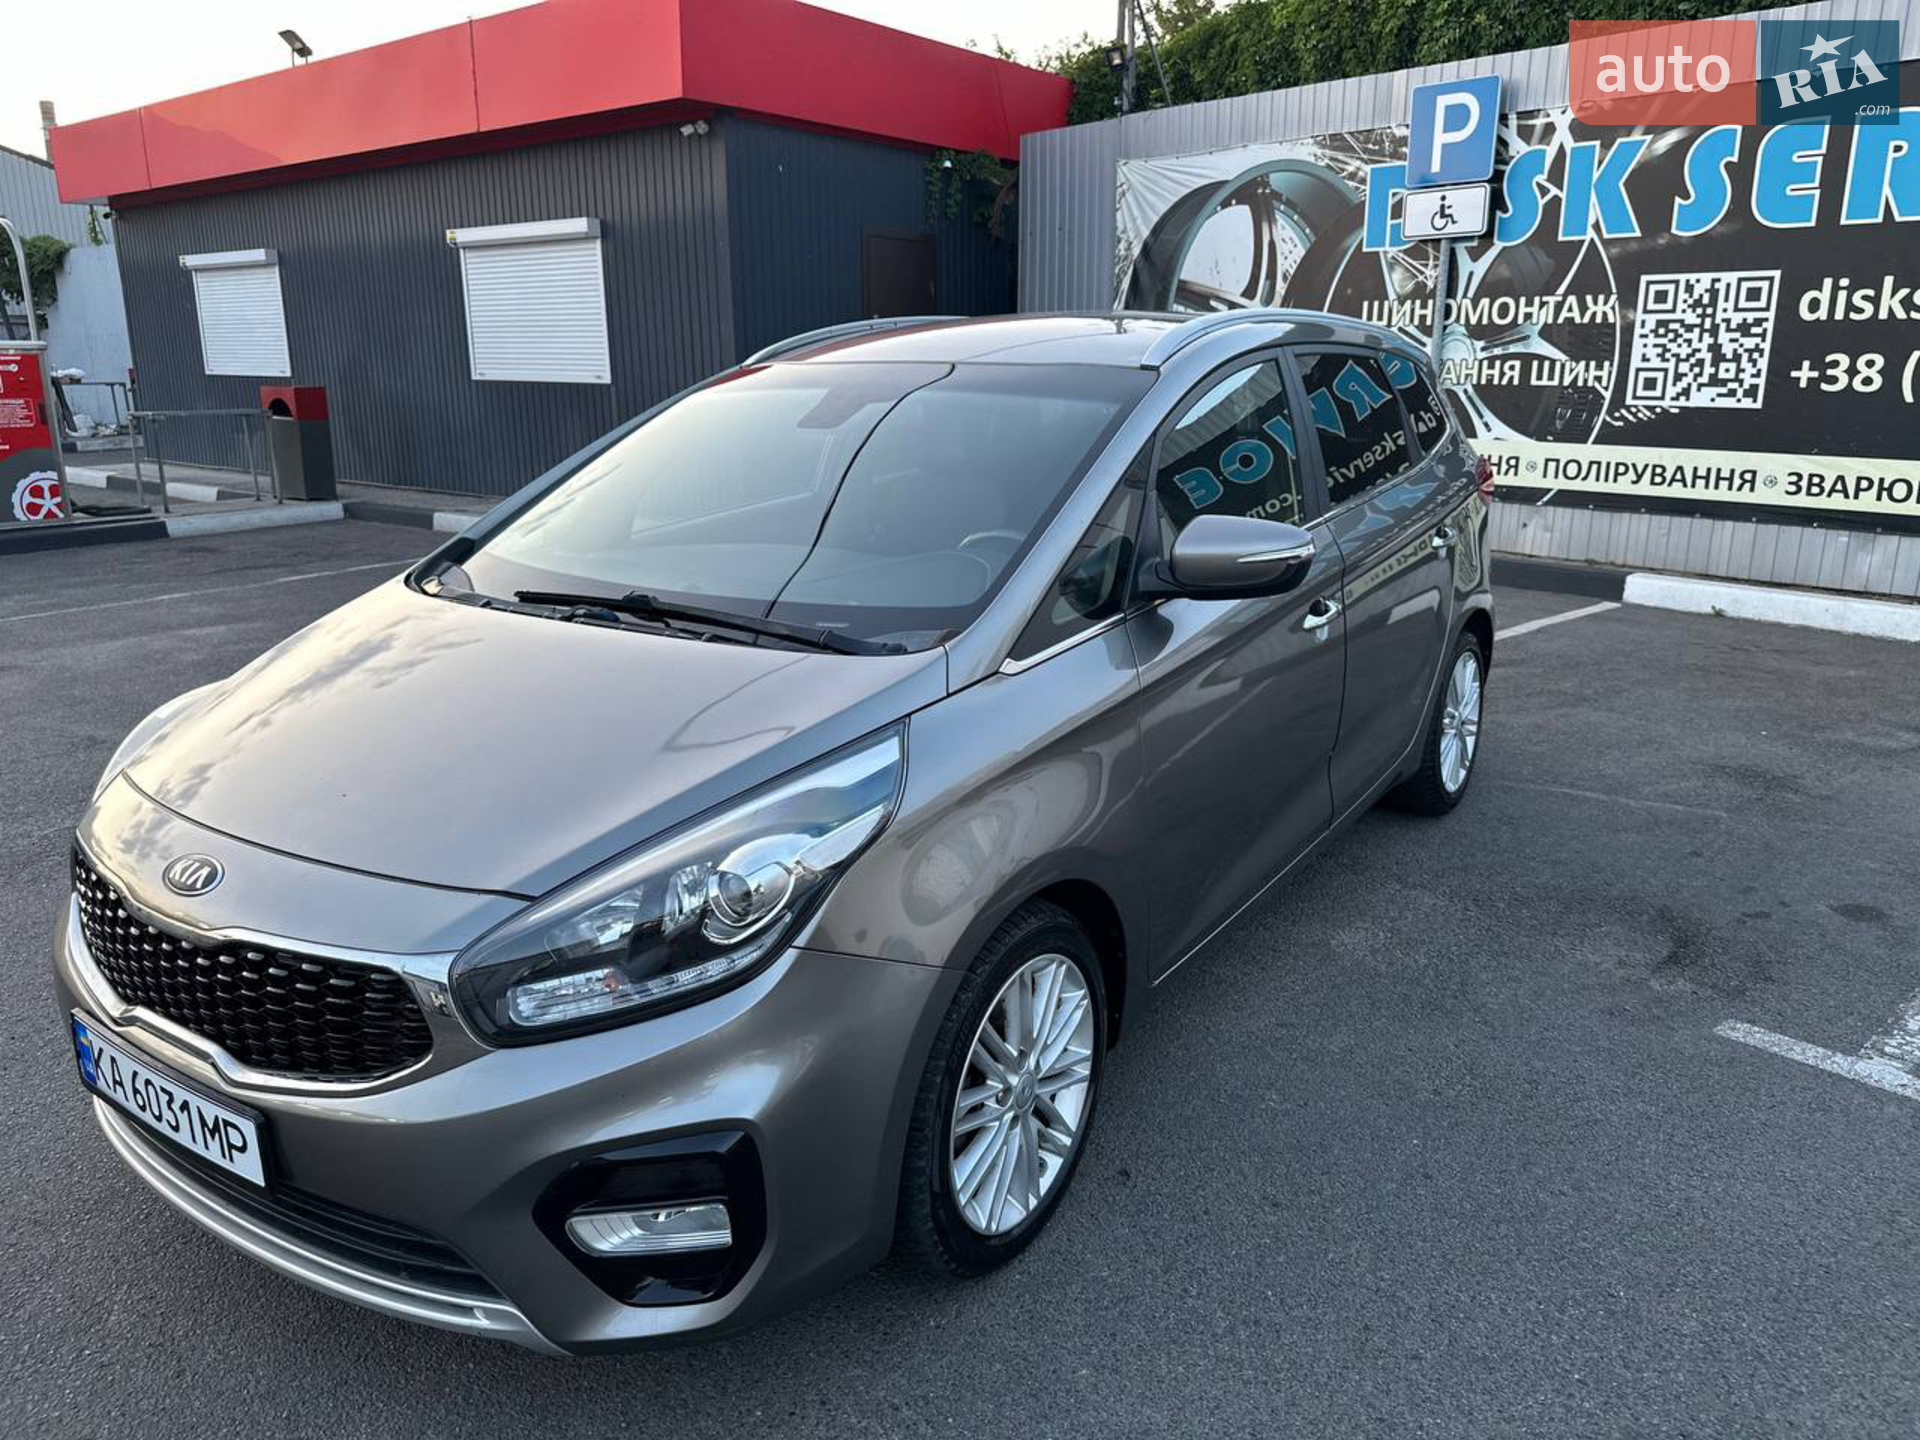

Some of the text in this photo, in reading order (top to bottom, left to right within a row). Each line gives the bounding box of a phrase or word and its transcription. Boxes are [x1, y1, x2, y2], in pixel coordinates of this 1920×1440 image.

[1430, 92, 1480, 173] P
[1362, 134, 1654, 252] DSK
[1530, 360, 1615, 388] ШИН
[1790, 353, 1885, 393] +38
[1542, 457, 1758, 493] ПОЛІРУВАННЯ
